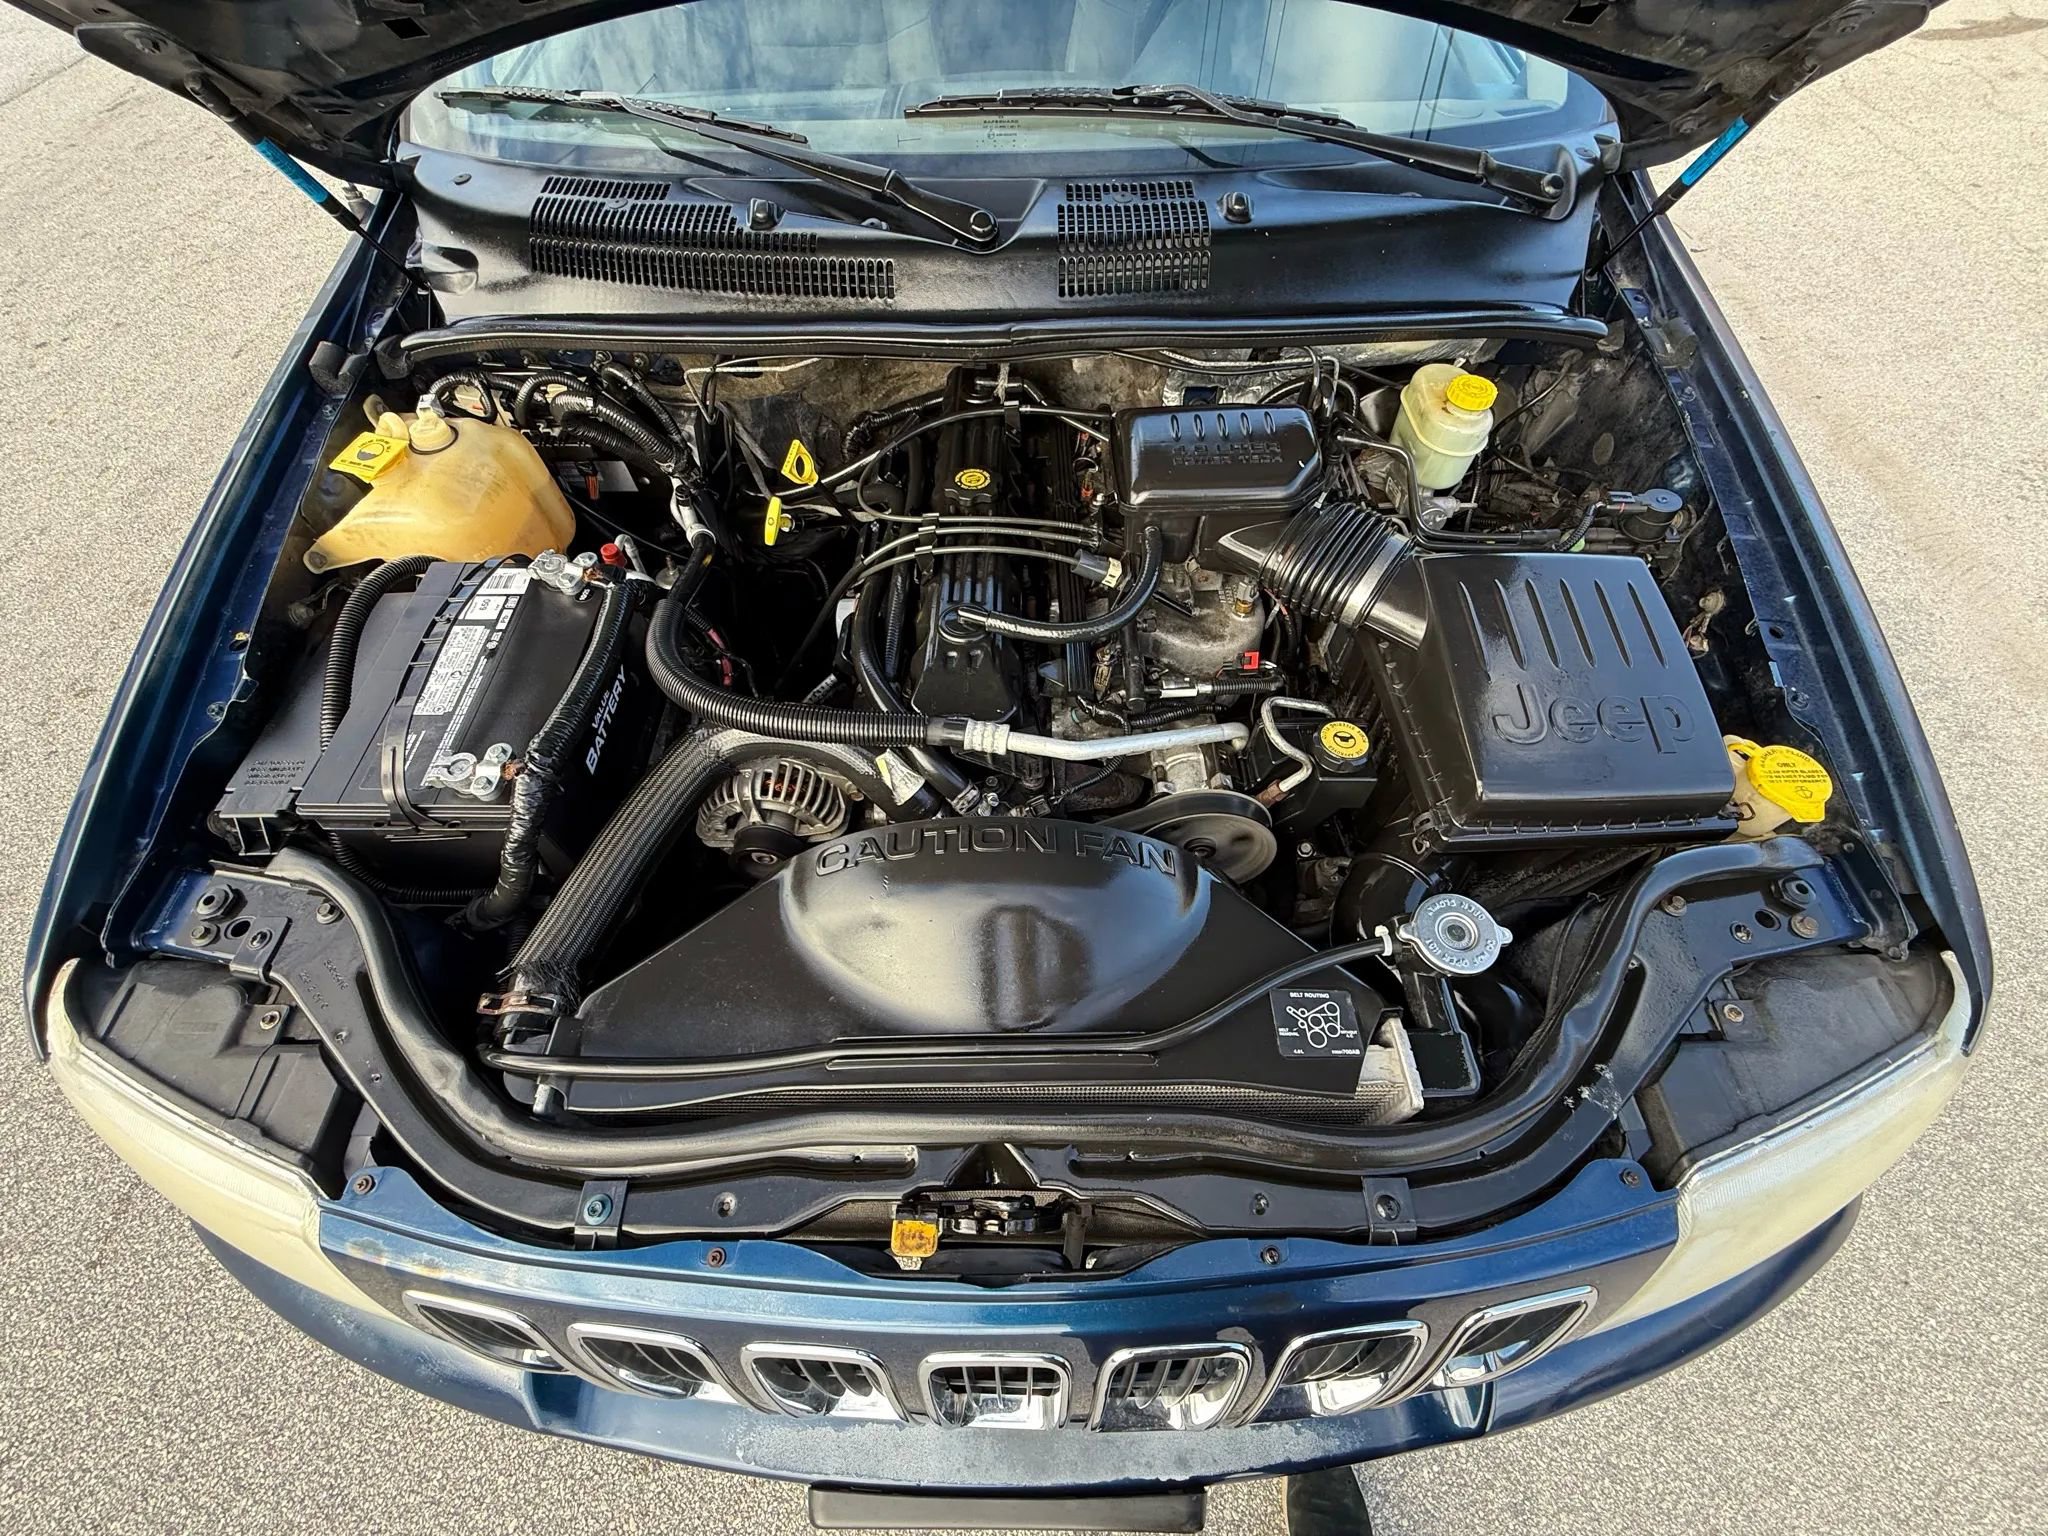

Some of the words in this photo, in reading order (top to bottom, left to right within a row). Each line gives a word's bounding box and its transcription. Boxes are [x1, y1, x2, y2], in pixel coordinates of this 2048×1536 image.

[585, 663, 626, 775] BATTERY
[592, 690, 610, 729] VALUE
[1491, 682, 1695, 755] Jeep
[815, 823, 1057, 877] CAUTION
[1075, 828, 1177, 876] FAN
